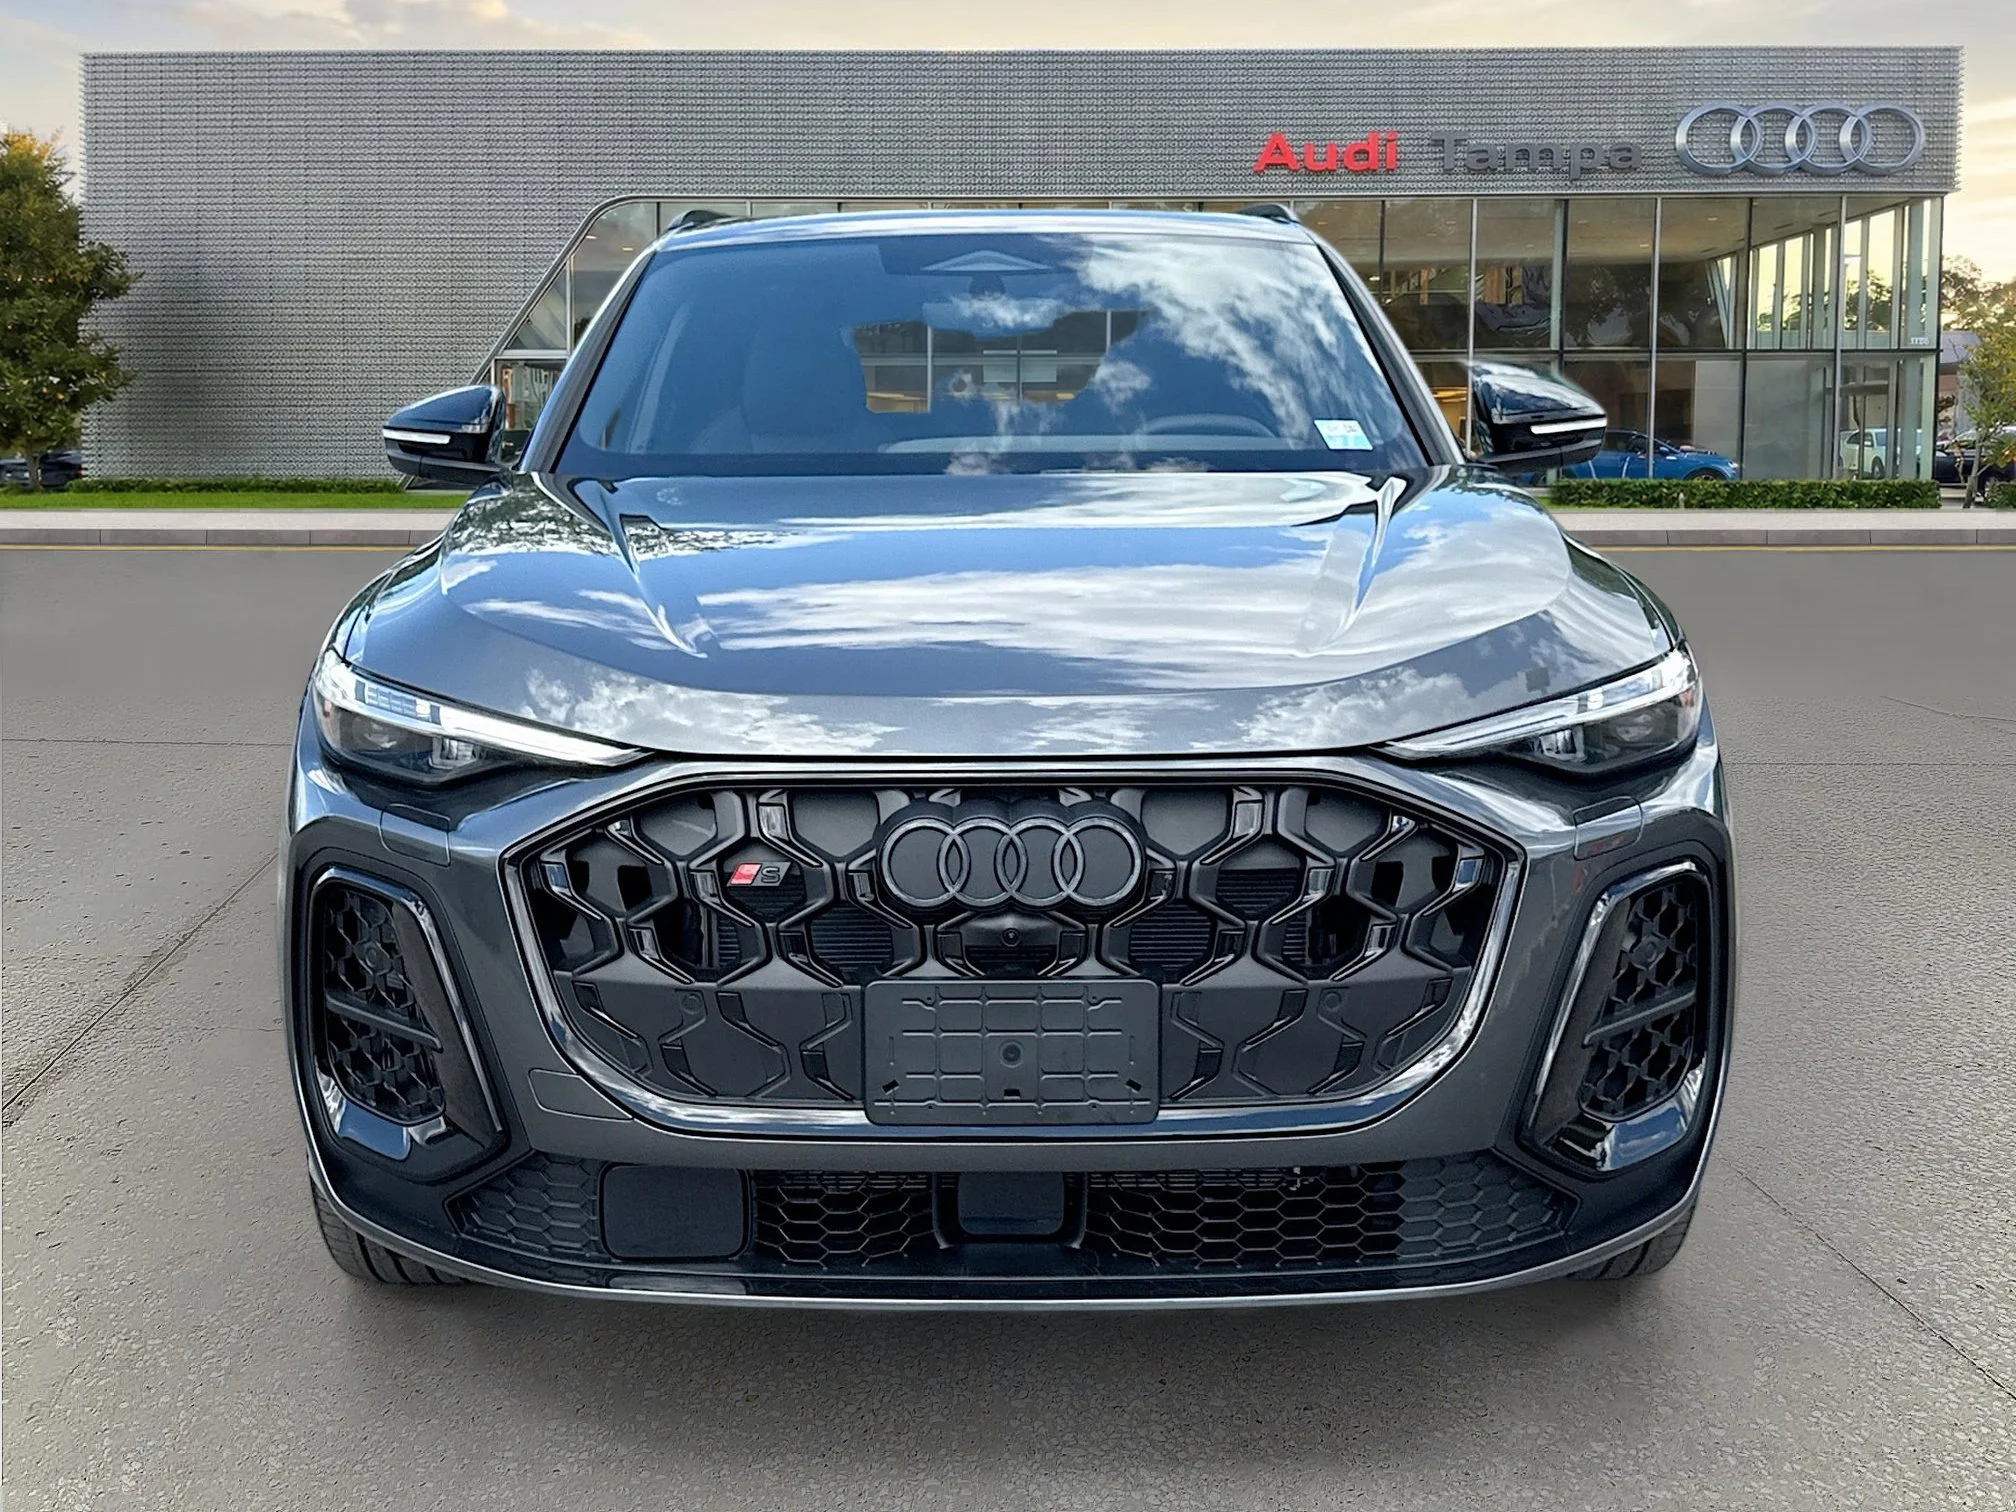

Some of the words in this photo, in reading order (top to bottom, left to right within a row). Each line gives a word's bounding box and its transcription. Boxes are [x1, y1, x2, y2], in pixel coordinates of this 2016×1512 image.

[1253, 130, 1398, 173] Audi
[1430, 131, 1643, 181] Tampa
[761, 866, 780, 883] S
